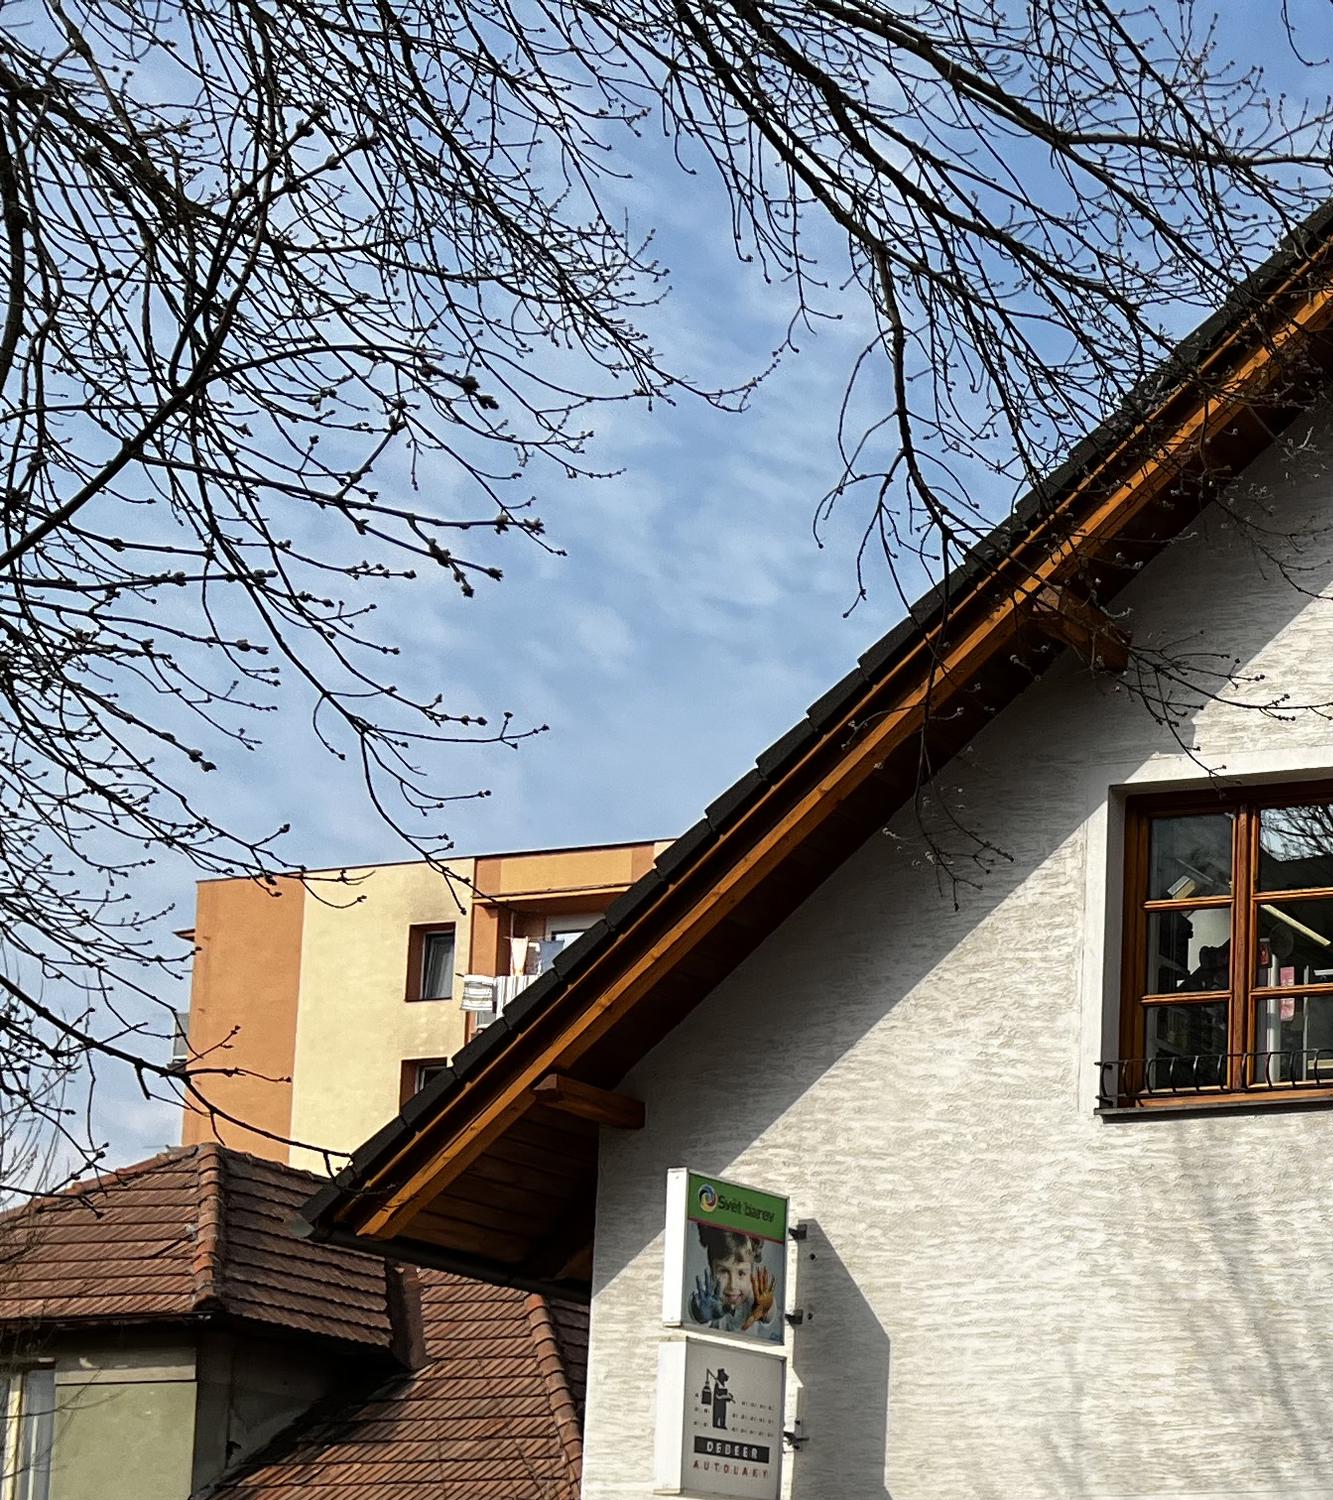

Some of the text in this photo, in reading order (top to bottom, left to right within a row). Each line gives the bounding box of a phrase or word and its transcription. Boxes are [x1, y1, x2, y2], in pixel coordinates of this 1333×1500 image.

[745, 1202, 776, 1223] barev
[706, 1441, 758, 1460] DEBEER
[693, 1459, 768, 1478] AUTOLAKY
